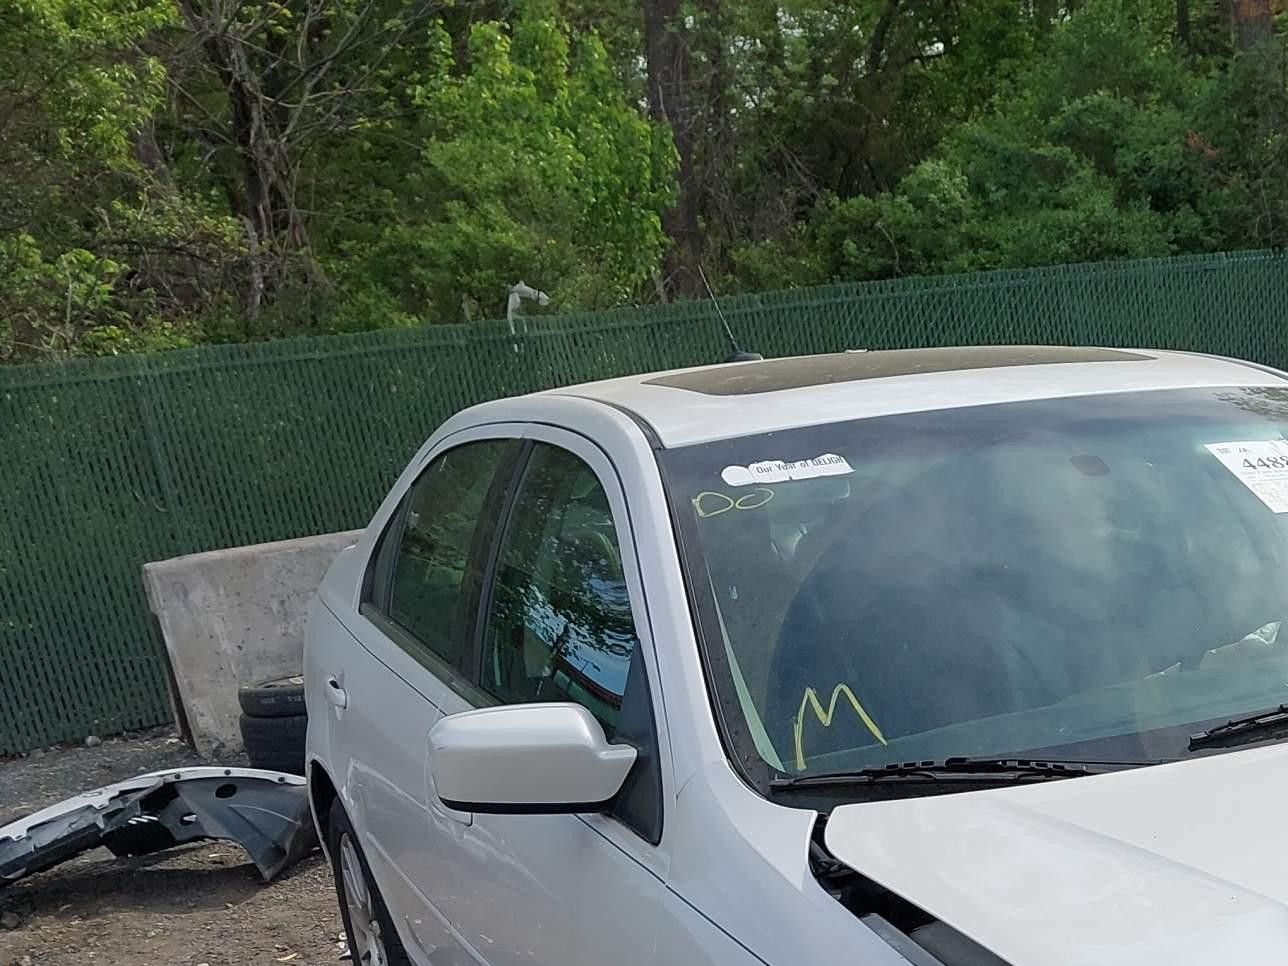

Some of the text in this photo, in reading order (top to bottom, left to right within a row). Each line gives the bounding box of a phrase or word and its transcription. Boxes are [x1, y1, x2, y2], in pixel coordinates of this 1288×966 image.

[756, 466, 773, 474] Our
[775, 463, 797, 471] Year
[800, 458, 810, 468] of
[792, 683, 889, 770] M
